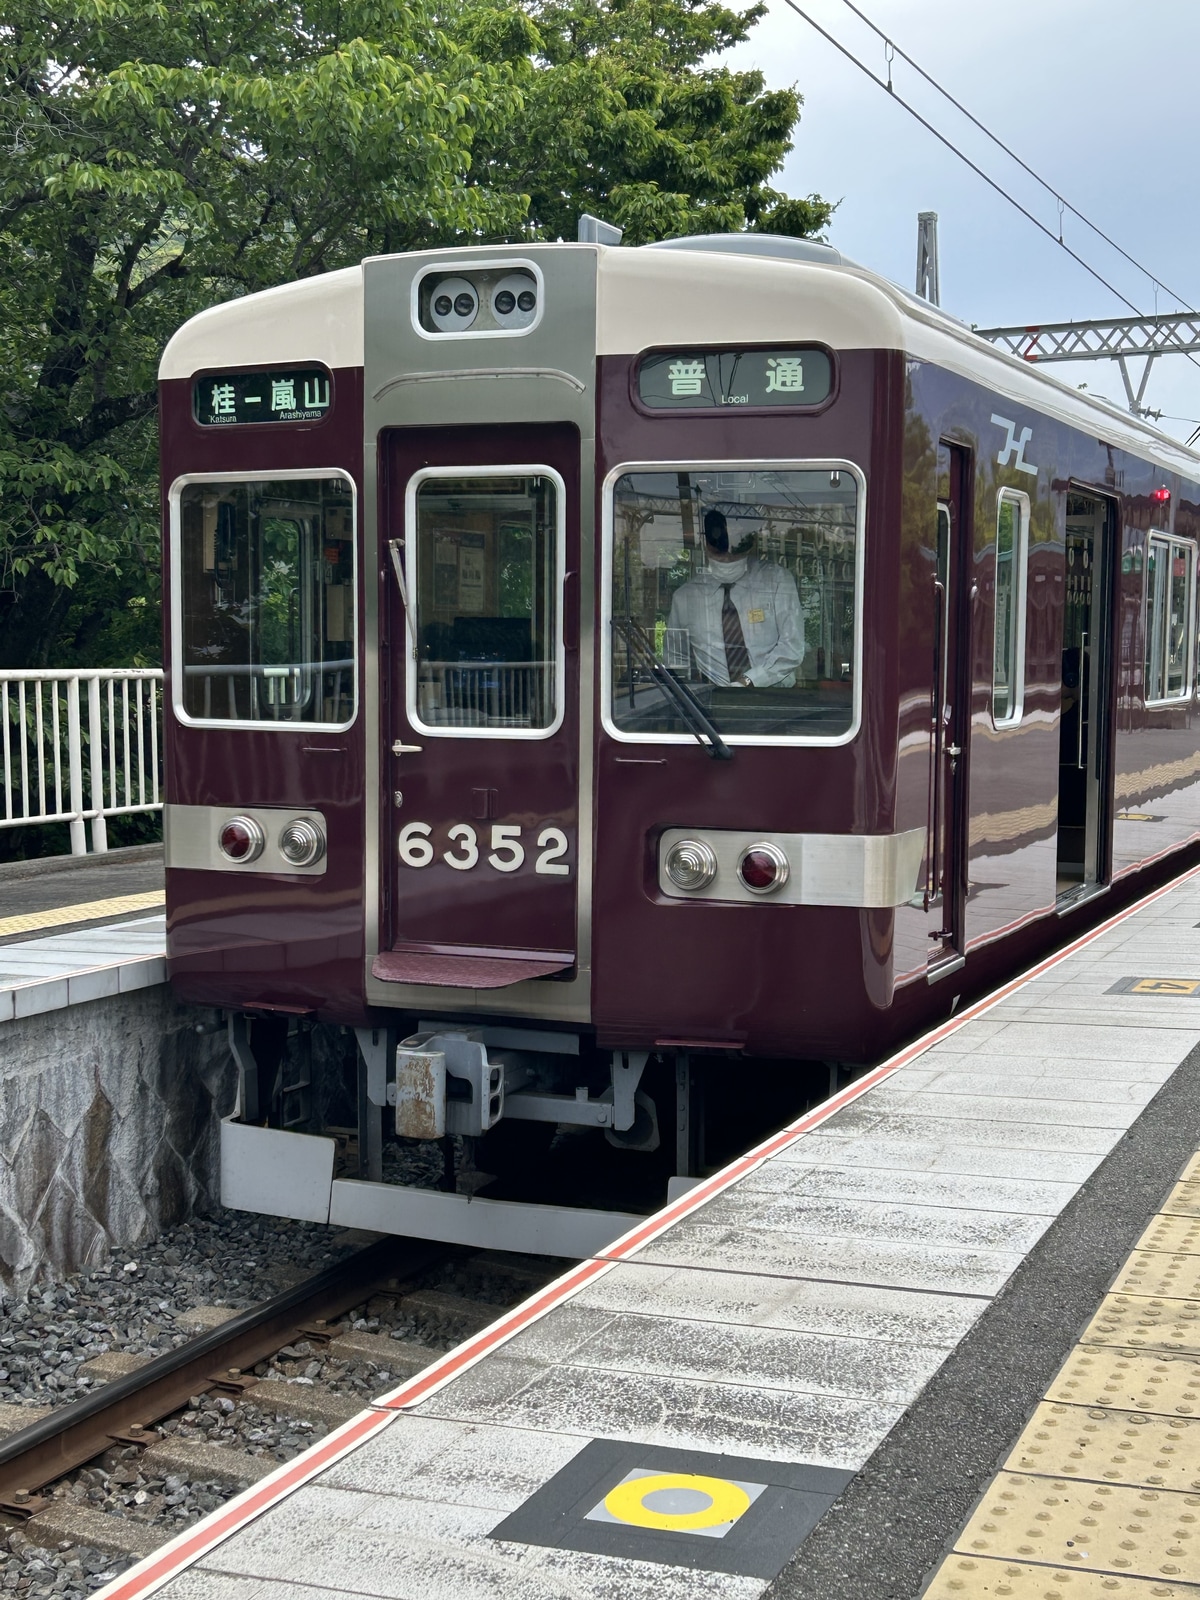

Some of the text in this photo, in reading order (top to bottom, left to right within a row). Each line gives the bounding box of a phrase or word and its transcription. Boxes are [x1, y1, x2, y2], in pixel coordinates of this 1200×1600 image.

[668, 357, 805, 395] 普通
[721, 394, 749, 404] Local
[210, 415, 237, 424] Katsura
[279, 410, 321, 420] Arashiyama
[398, 821, 570, 875] 6352
